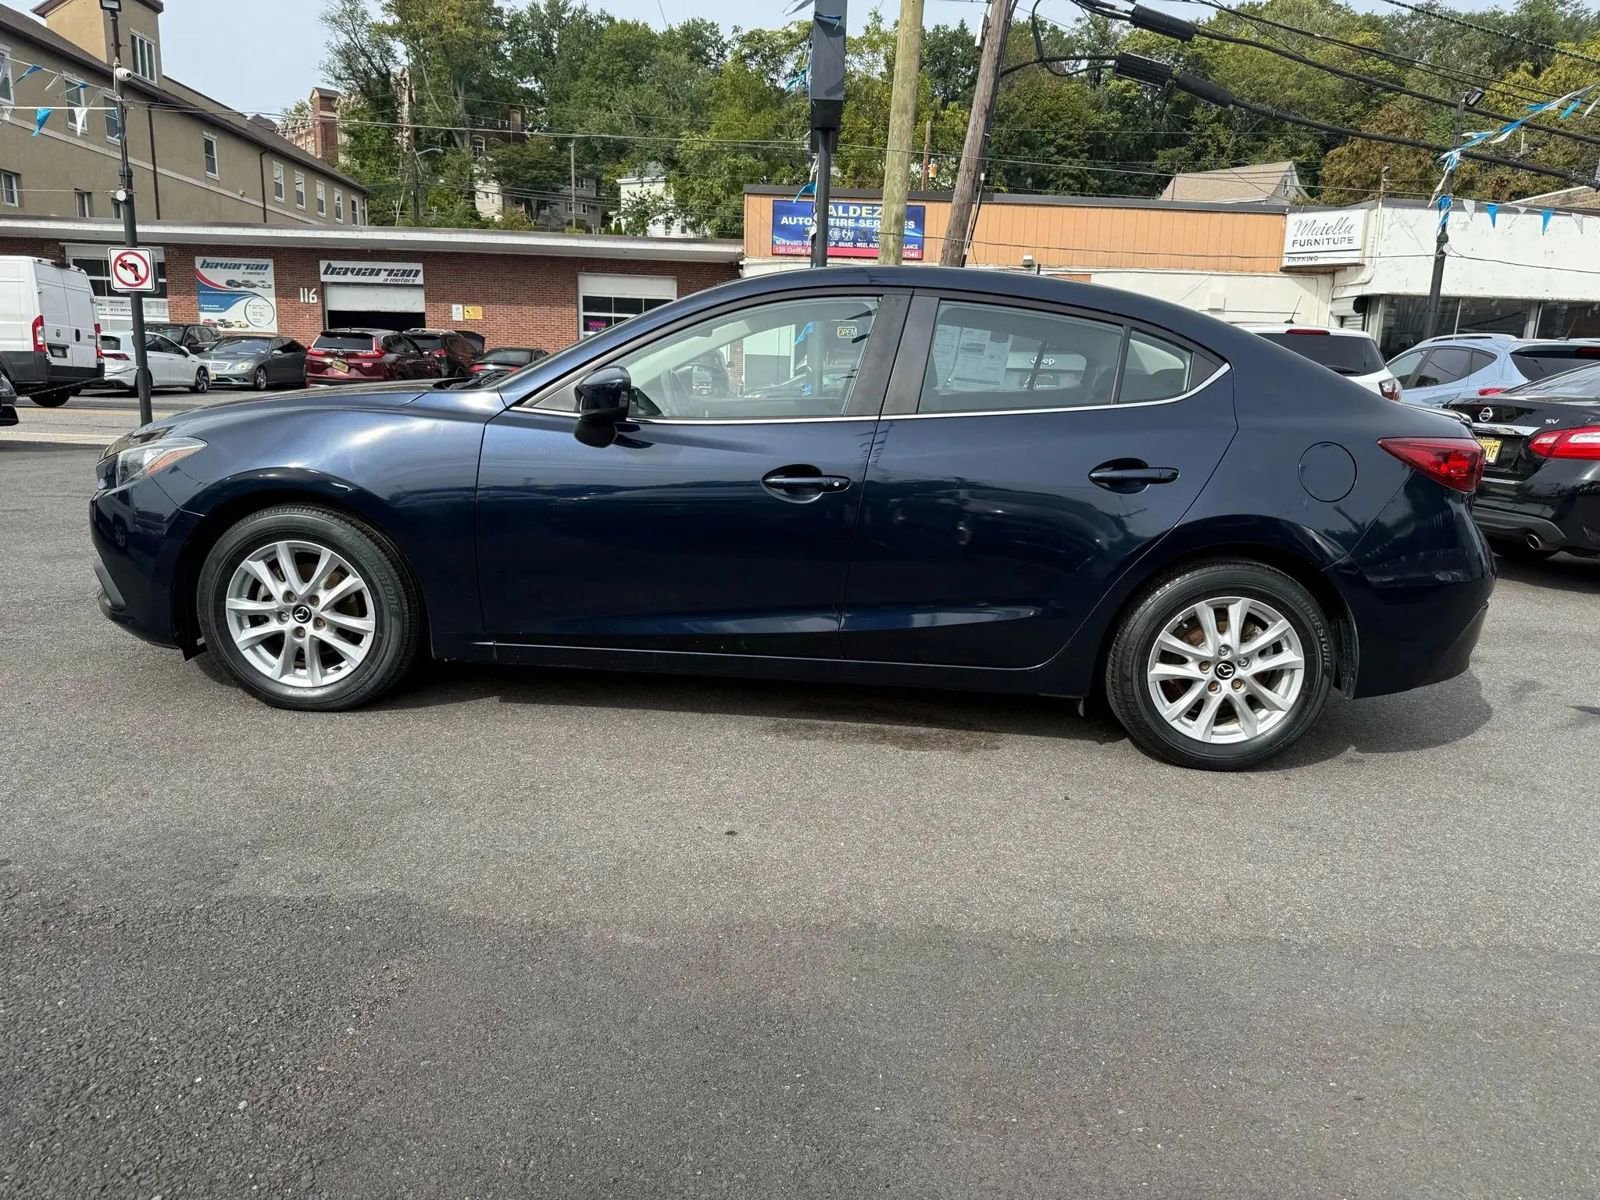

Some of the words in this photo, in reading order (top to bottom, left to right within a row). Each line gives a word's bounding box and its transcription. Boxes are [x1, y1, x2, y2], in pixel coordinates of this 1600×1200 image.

[828, 205, 883, 218] ALDEZ
[781, 216, 813, 225] AUTO
[828, 218, 856, 228] TIRE
[1294, 216, 1355, 237] Maiella
[1292, 236, 1354, 247] FURNITURE
[199, 258, 270, 271] bavarian
[322, 262, 421, 278] bavarian
[299, 287, 318, 303] 116
[1030, 355, 1055, 366] Jep
[1291, 588, 1332, 669] RIDGESTONE
